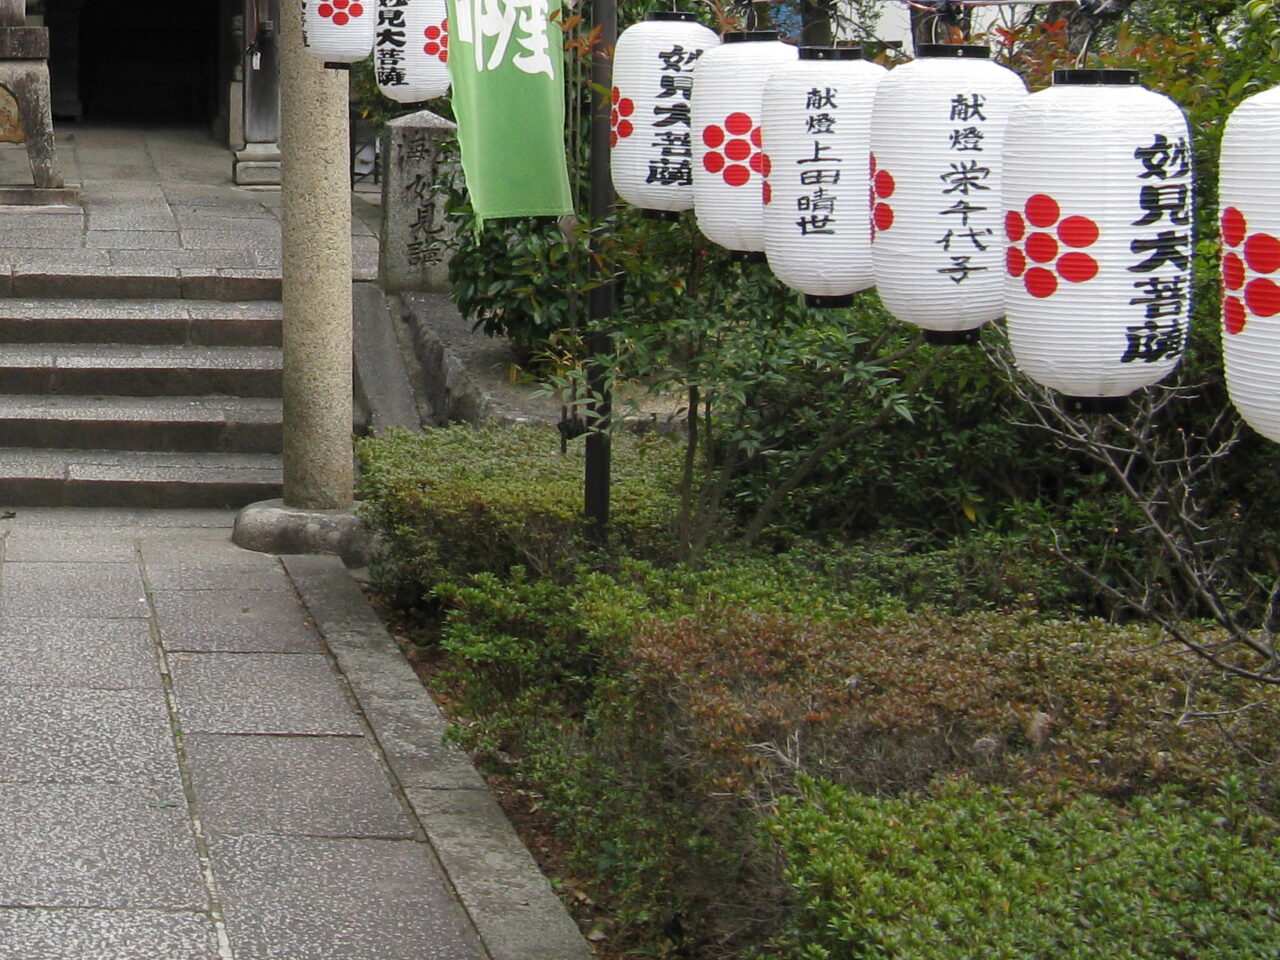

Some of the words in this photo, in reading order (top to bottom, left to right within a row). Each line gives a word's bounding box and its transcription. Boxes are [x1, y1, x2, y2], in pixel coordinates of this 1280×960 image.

[795, 87, 843, 236] 献燈上田晴世
[1121, 133, 1191, 363] 妙見大菩薩
